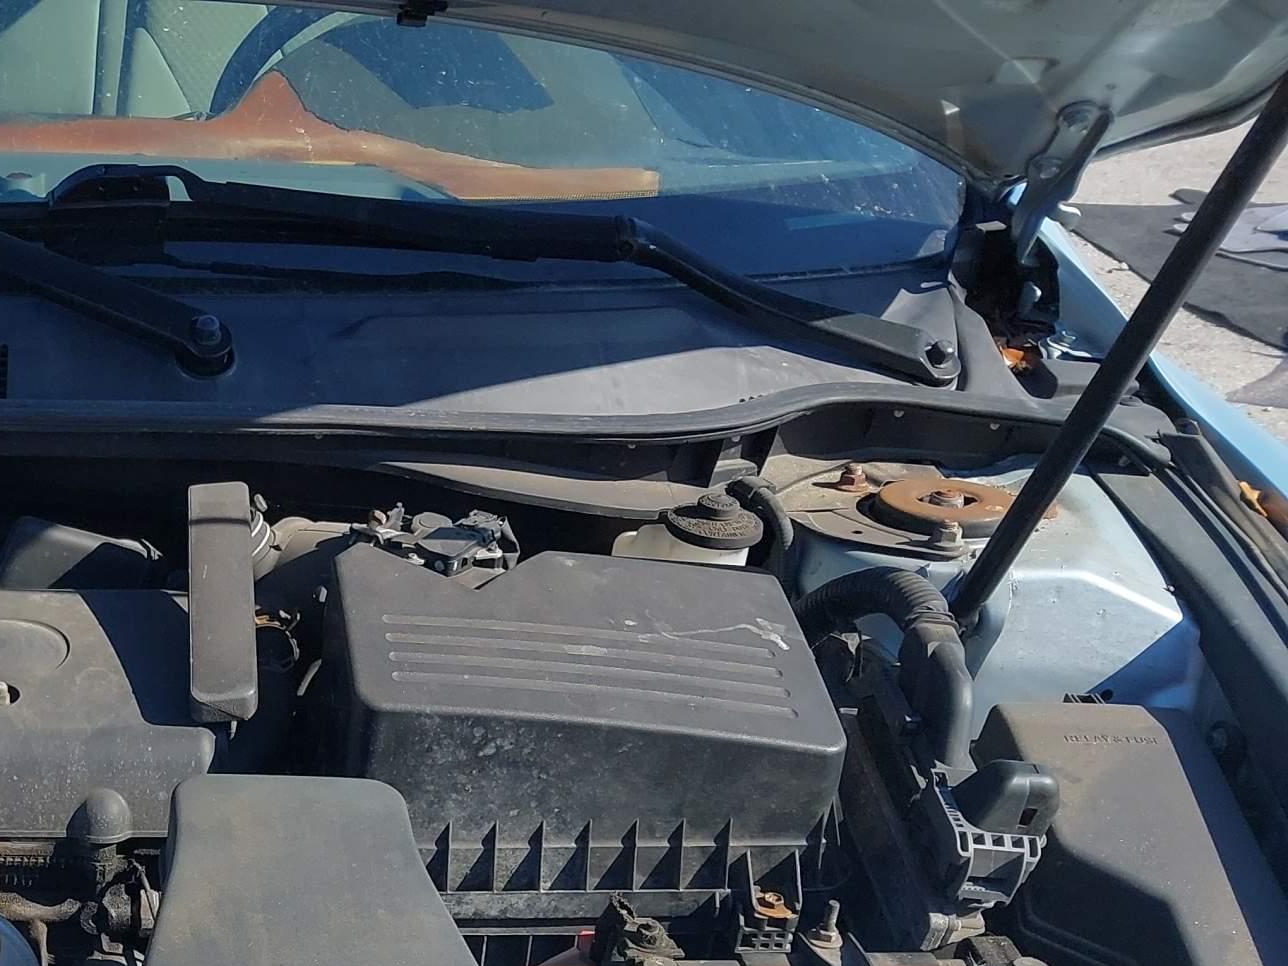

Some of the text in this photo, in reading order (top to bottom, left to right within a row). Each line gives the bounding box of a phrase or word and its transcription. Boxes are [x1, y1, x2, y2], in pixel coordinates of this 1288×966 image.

[1063, 735, 1160, 745] RELAY & FUSE
